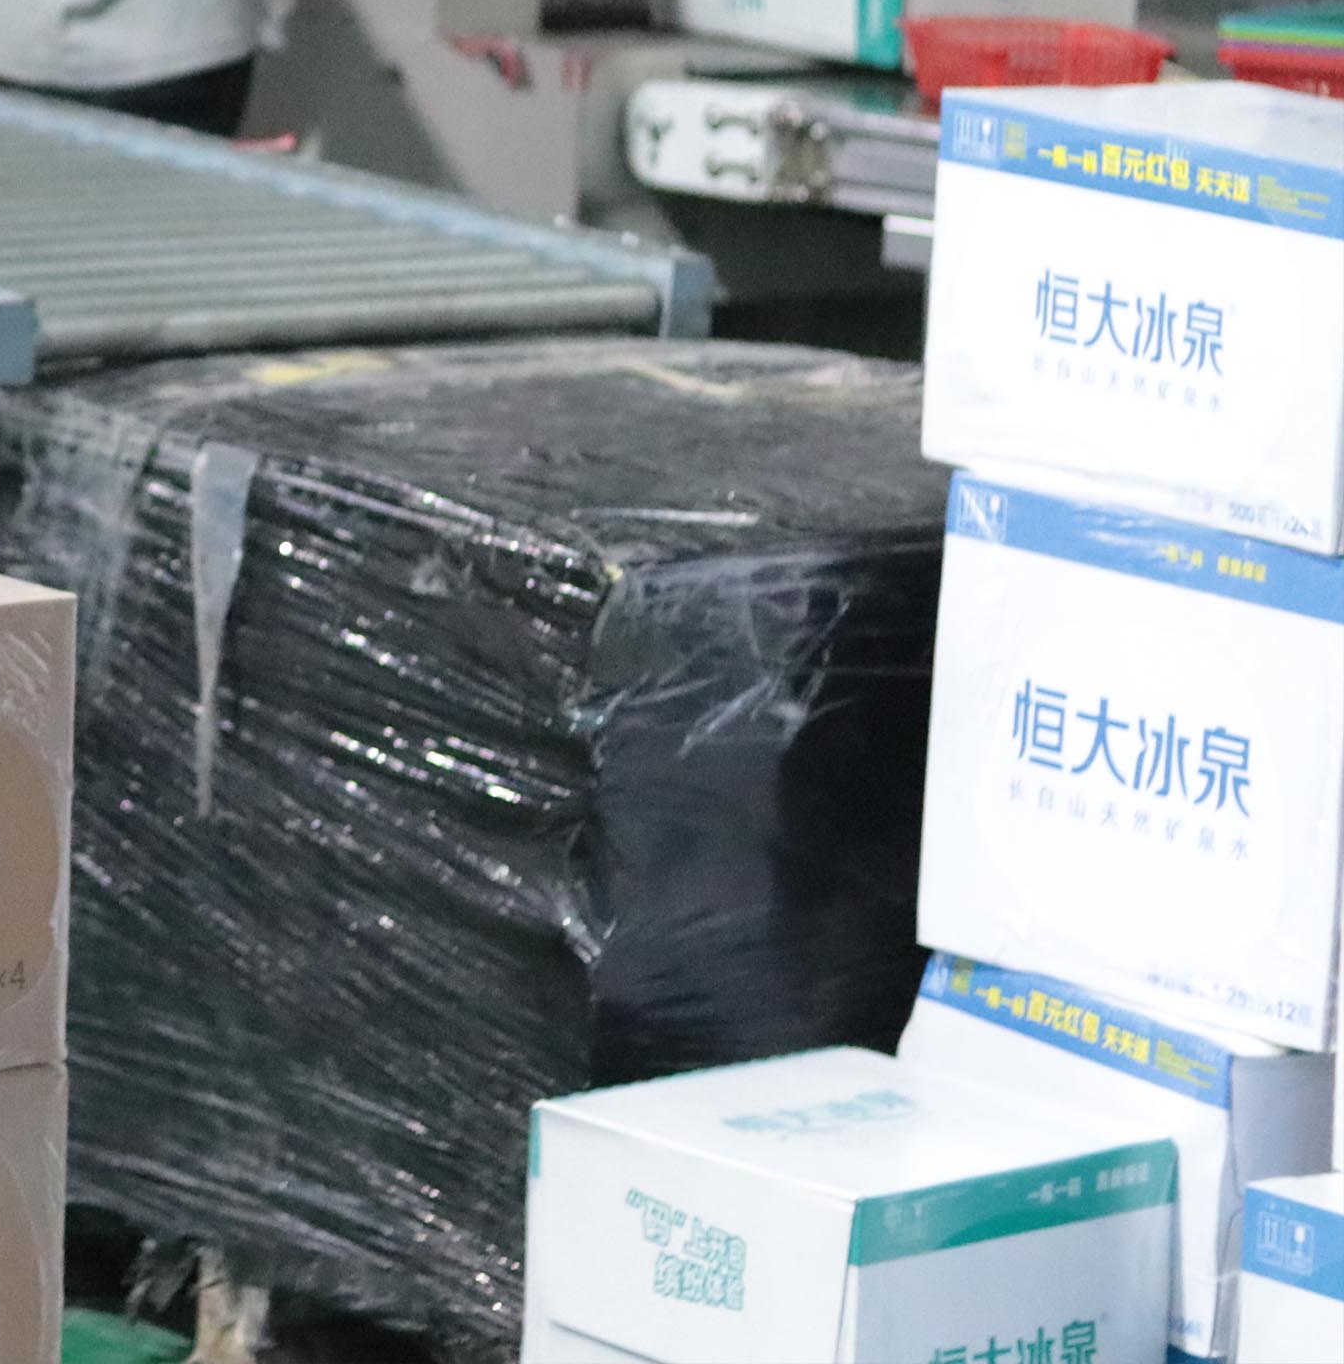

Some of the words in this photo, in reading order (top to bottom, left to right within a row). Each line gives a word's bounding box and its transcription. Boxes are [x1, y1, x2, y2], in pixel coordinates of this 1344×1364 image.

[1035, 268, 1225, 378] 恒大冰泉
[1012, 679, 1252, 820] 恒大冰泉
